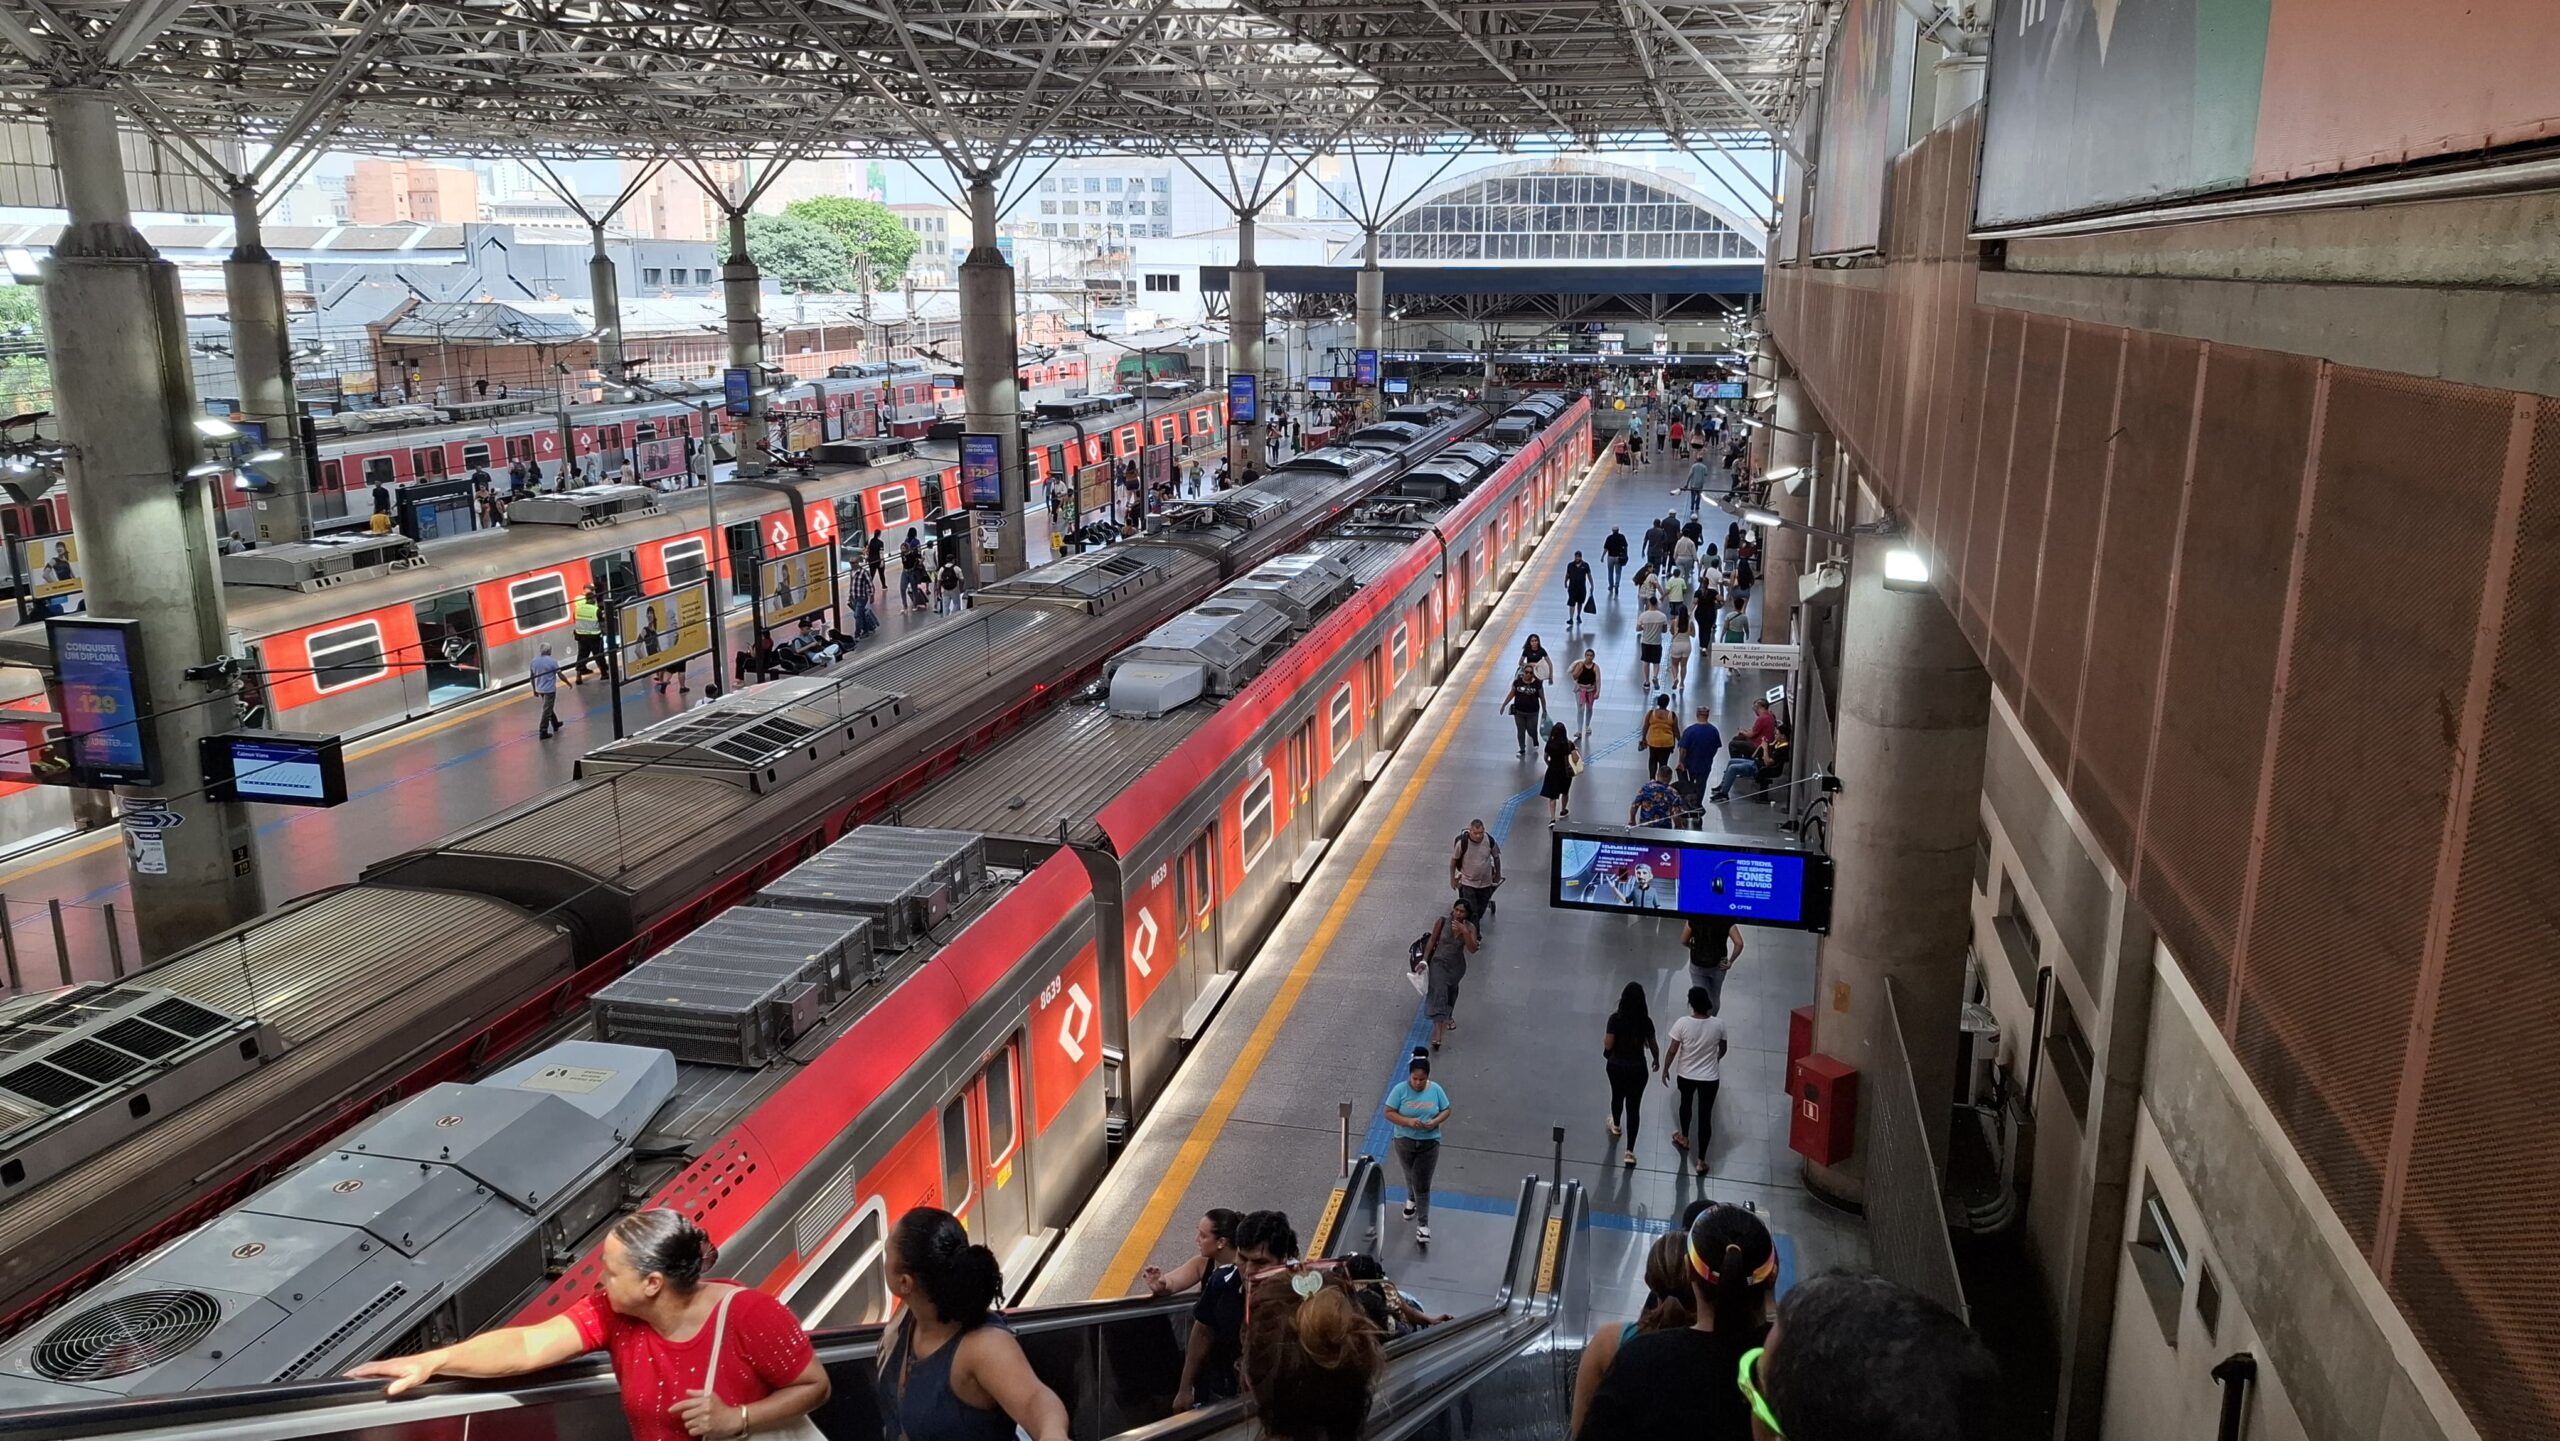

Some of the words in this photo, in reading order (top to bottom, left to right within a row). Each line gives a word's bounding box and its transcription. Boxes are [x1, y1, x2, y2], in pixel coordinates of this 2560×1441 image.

[970, 468, 989, 477] 129
[66, 642, 117, 653] CONQUISTE
[64, 651, 80, 660] UM
[80, 652, 120, 662] DIPLOMA
[79, 695, 118, 714] 129
[1151, 862, 1168, 890] H639
[1736, 871, 1773, 882] FONES
[1040, 975, 1062, 1010] 8639
